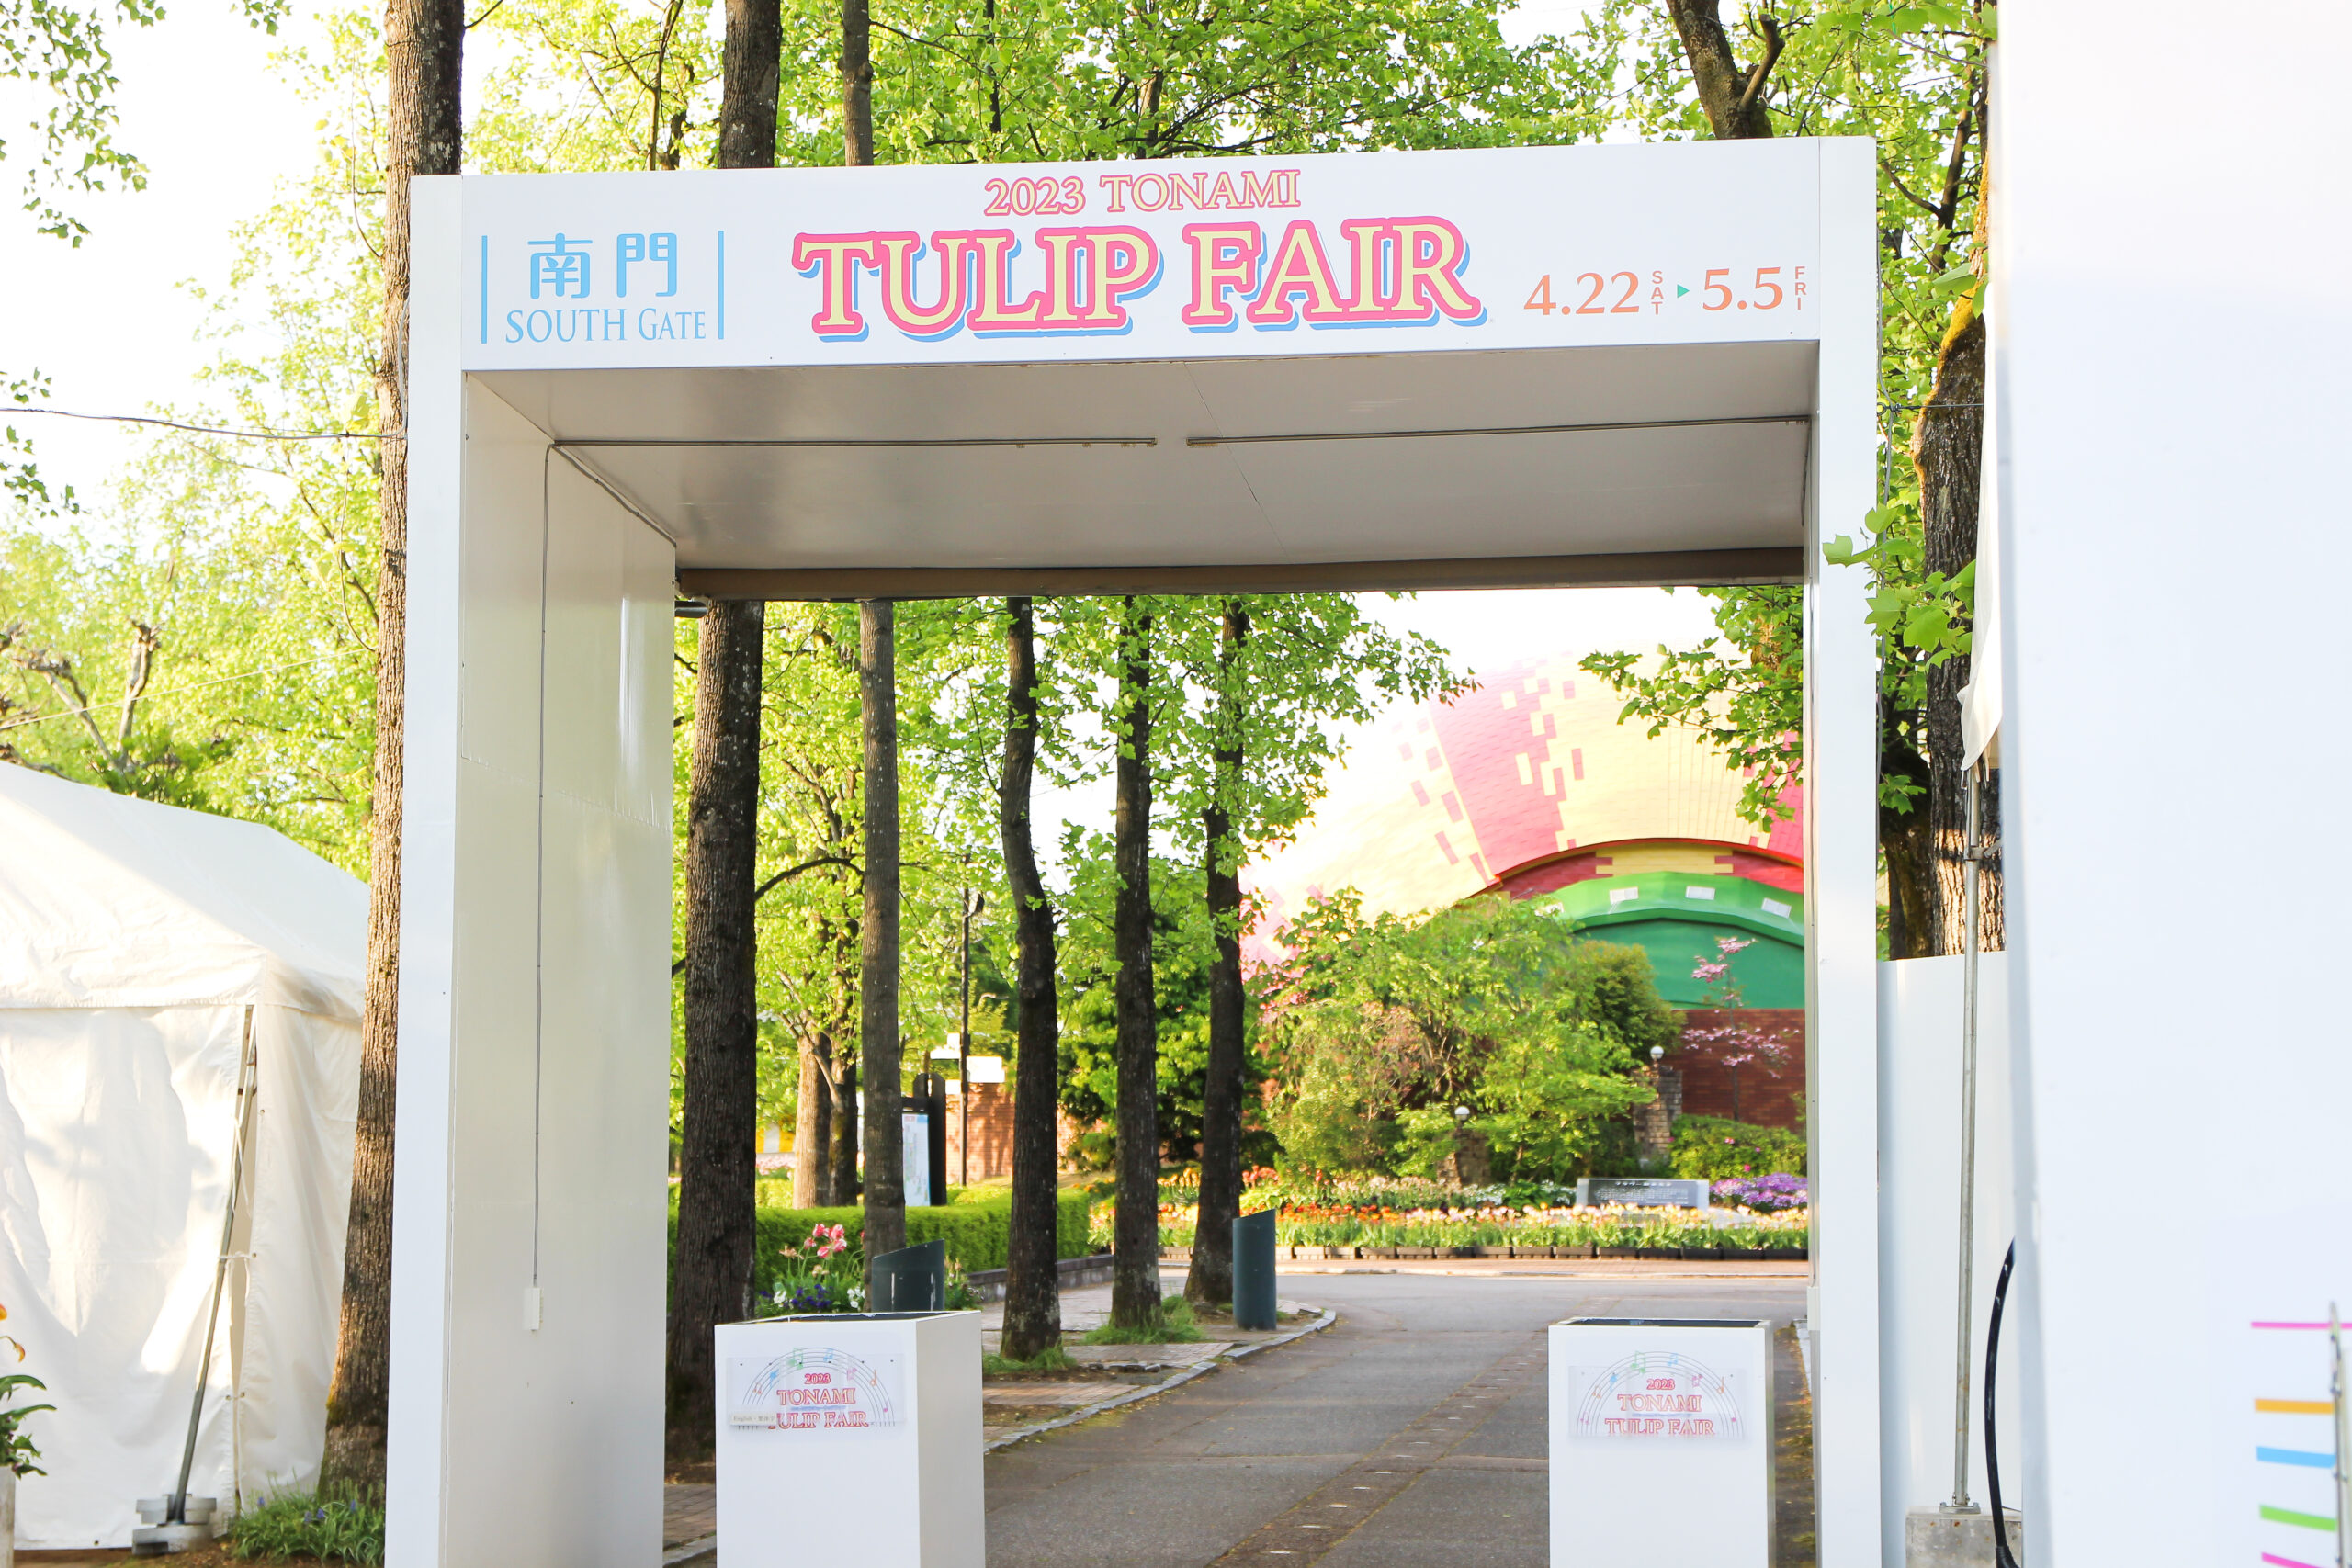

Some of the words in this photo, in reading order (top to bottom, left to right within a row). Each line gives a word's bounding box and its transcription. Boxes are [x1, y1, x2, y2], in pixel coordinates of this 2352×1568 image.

[984, 175, 1087, 217] 2023
[1100, 168, 1301, 214] TONAMI
[527, 232, 678, 299] 南門
[792, 225, 1164, 344] TULIP
[1182, 216, 1488, 333] FAIR
[1523, 271, 1640, 316] 4.22
[1650, 270, 1665, 315] SAT
[1702, 266, 1784, 311] 5.5
[1794, 265, 1807, 311] FRI
[505, 308, 628, 344] SOUTH
[639, 307, 707, 343] GATE
[804, 1372, 831, 1385] 2023
[1646, 1378, 1676, 1391] 2023
[776, 1387, 856, 1406] TONAMI
[1617, 1393, 1702, 1413] TONAMI
[768, 1412, 820, 1430] ULIP
[825, 1410, 869, 1428] FAIR
[1605, 1418, 1665, 1437] TULIP
[1668, 1418, 1716, 1437] FAIR
